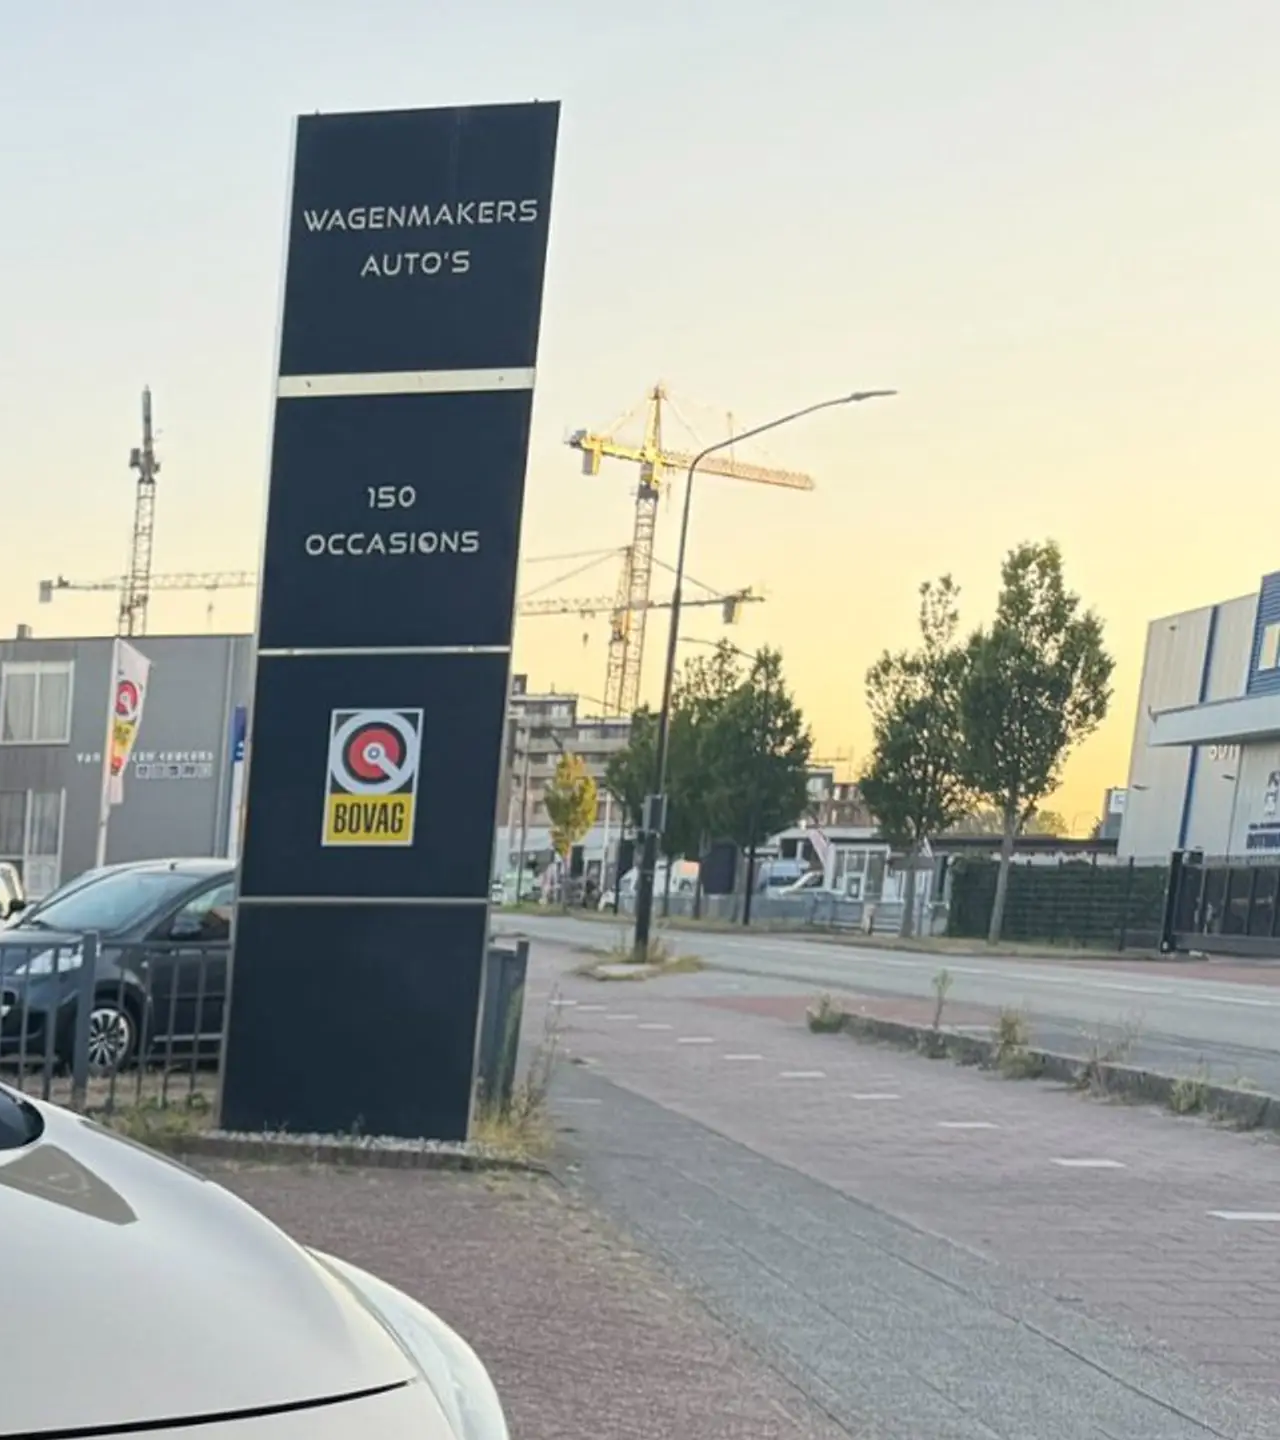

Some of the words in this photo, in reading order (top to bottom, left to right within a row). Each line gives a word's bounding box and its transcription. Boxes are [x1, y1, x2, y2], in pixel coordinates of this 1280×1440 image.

[303, 199, 538, 232] WAGENMAKERS
[360, 250, 471, 277] AUTO'S
[367, 486, 417, 509] 150
[305, 531, 480, 556] OCCASIONS
[333, 802, 405, 834] BOVAG
